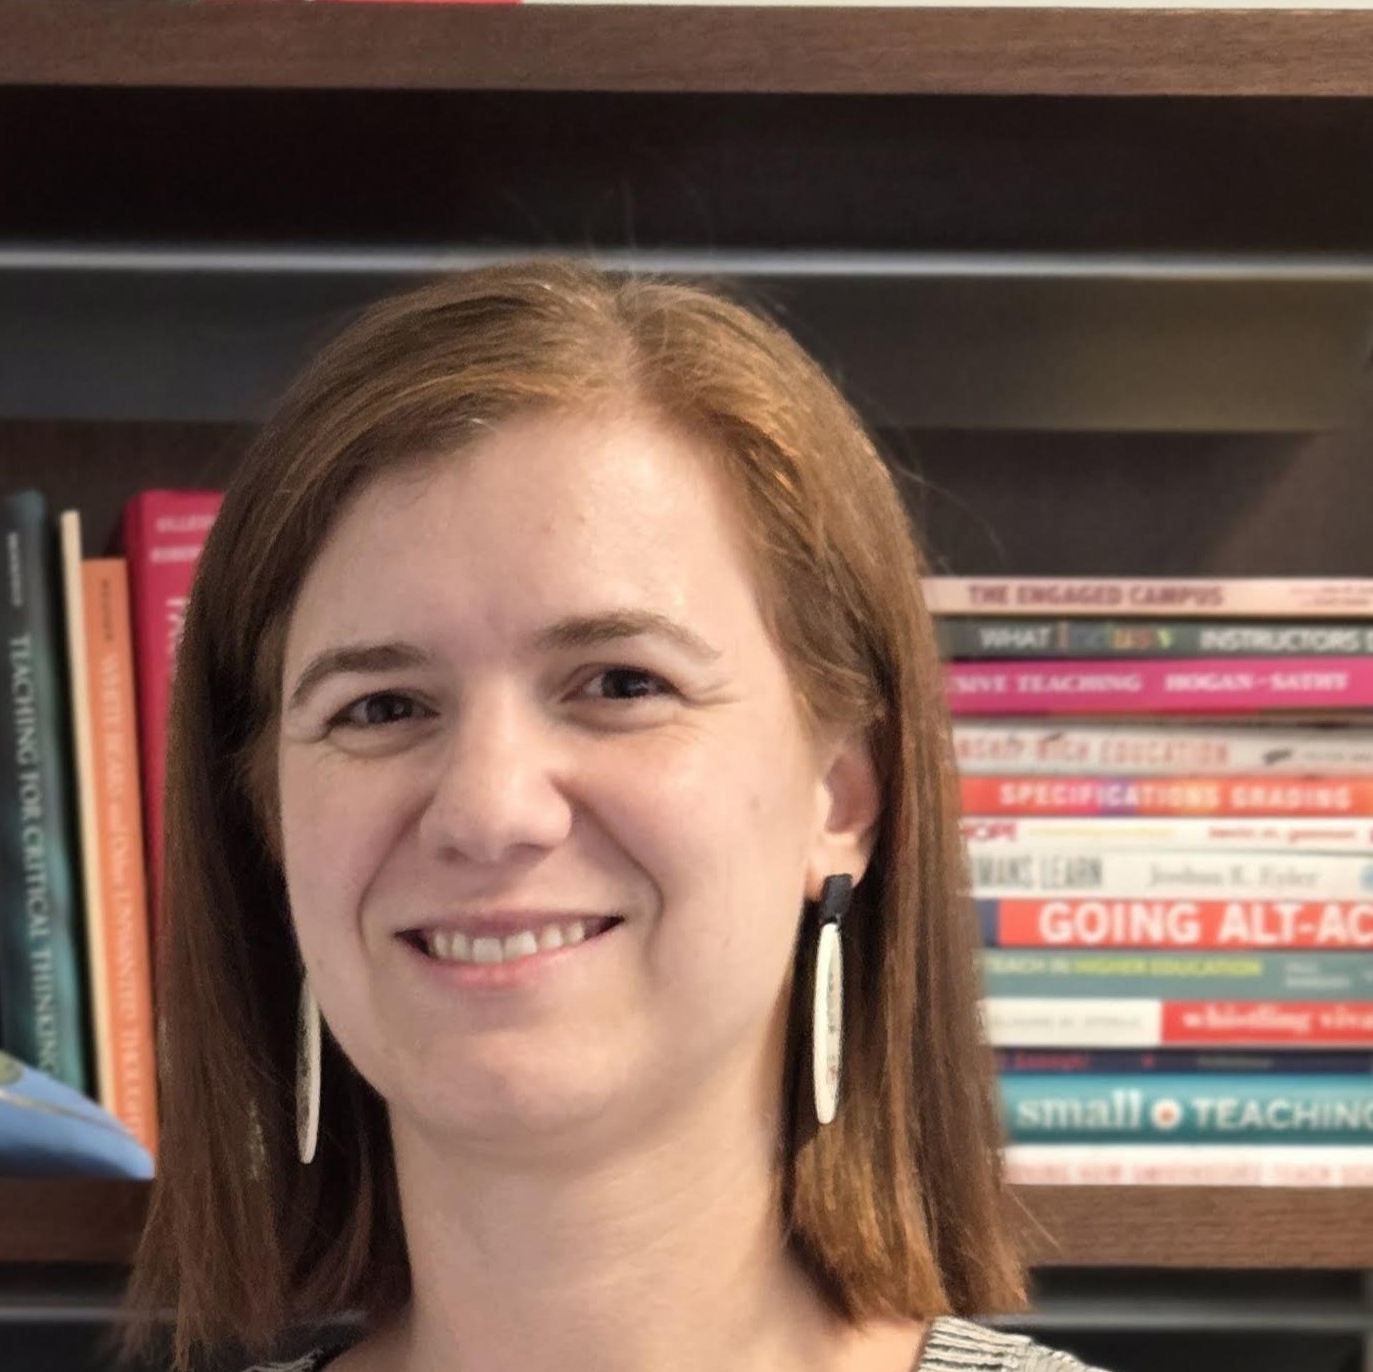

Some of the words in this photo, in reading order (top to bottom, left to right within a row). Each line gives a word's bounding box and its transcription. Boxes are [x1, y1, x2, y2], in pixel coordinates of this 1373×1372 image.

[967, 584, 1011, 606] THE
[1016, 584, 1122, 607] ENGAGED
[1128, 585, 1225, 607] CAMPUS
[978, 626, 1052, 650] WHAT
[1199, 627, 1361, 651] INSTRUCTORS
[8, 631, 41, 764] TEACHING
[1016, 672, 1142, 693] TEACHING
[1164, 671, 1254, 692] HOGAN
[1097, 736, 1232, 765] EDUCATION
[18, 770, 42, 819] FOR
[999, 782, 1220, 809] SPECIFICATIONS
[1230, 783, 1351, 809] GRADING
[21, 824, 51, 939] CRITICAL
[1040, 857, 1103, 889] LEARN
[1149, 862, 1224, 887] Joshua
[1037, 902, 1202, 945] GOING
[1216, 902, 1373, 944] ALT-AC
[1015, 1088, 1142, 1131] small
